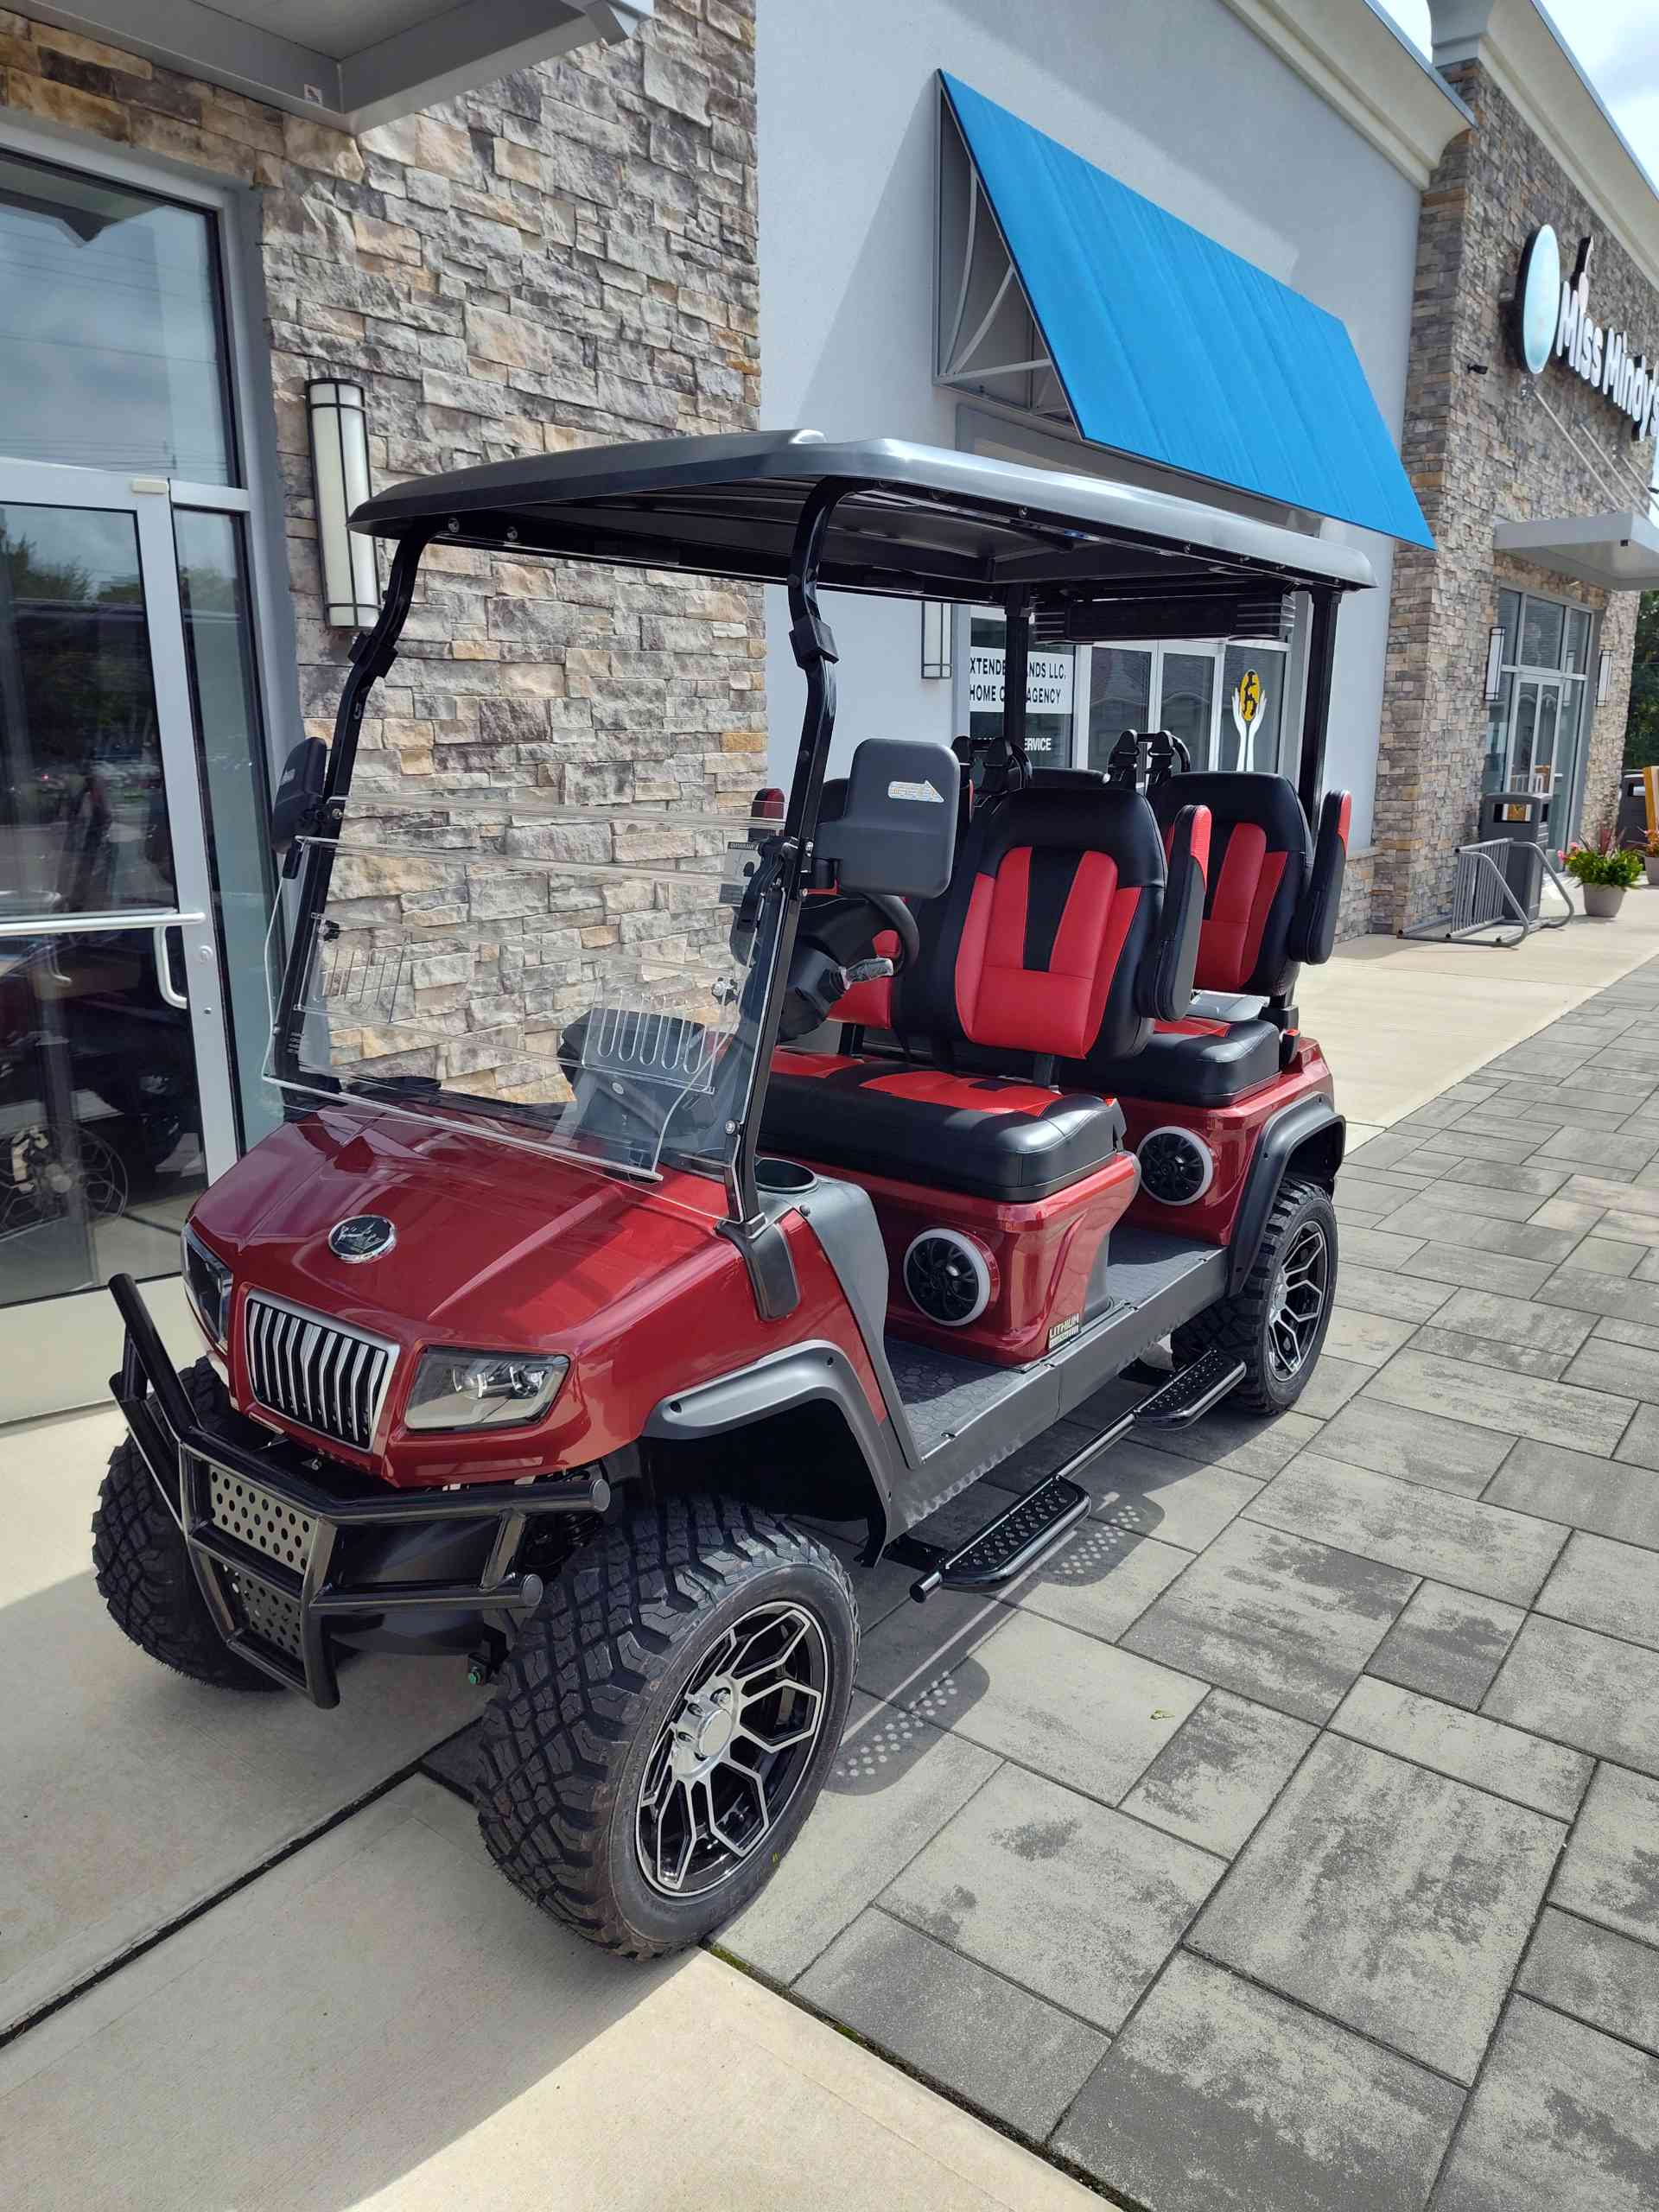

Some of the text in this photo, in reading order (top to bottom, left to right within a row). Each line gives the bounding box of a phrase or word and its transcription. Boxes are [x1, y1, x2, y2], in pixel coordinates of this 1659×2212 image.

[969, 658, 1006, 676] XTENDE
[1028, 662, 1046, 678] NDS
[969, 684, 996, 702] HOME
[1027, 687, 1061, 704] AGENCY
[1024, 737, 1052, 751] ERVICE
